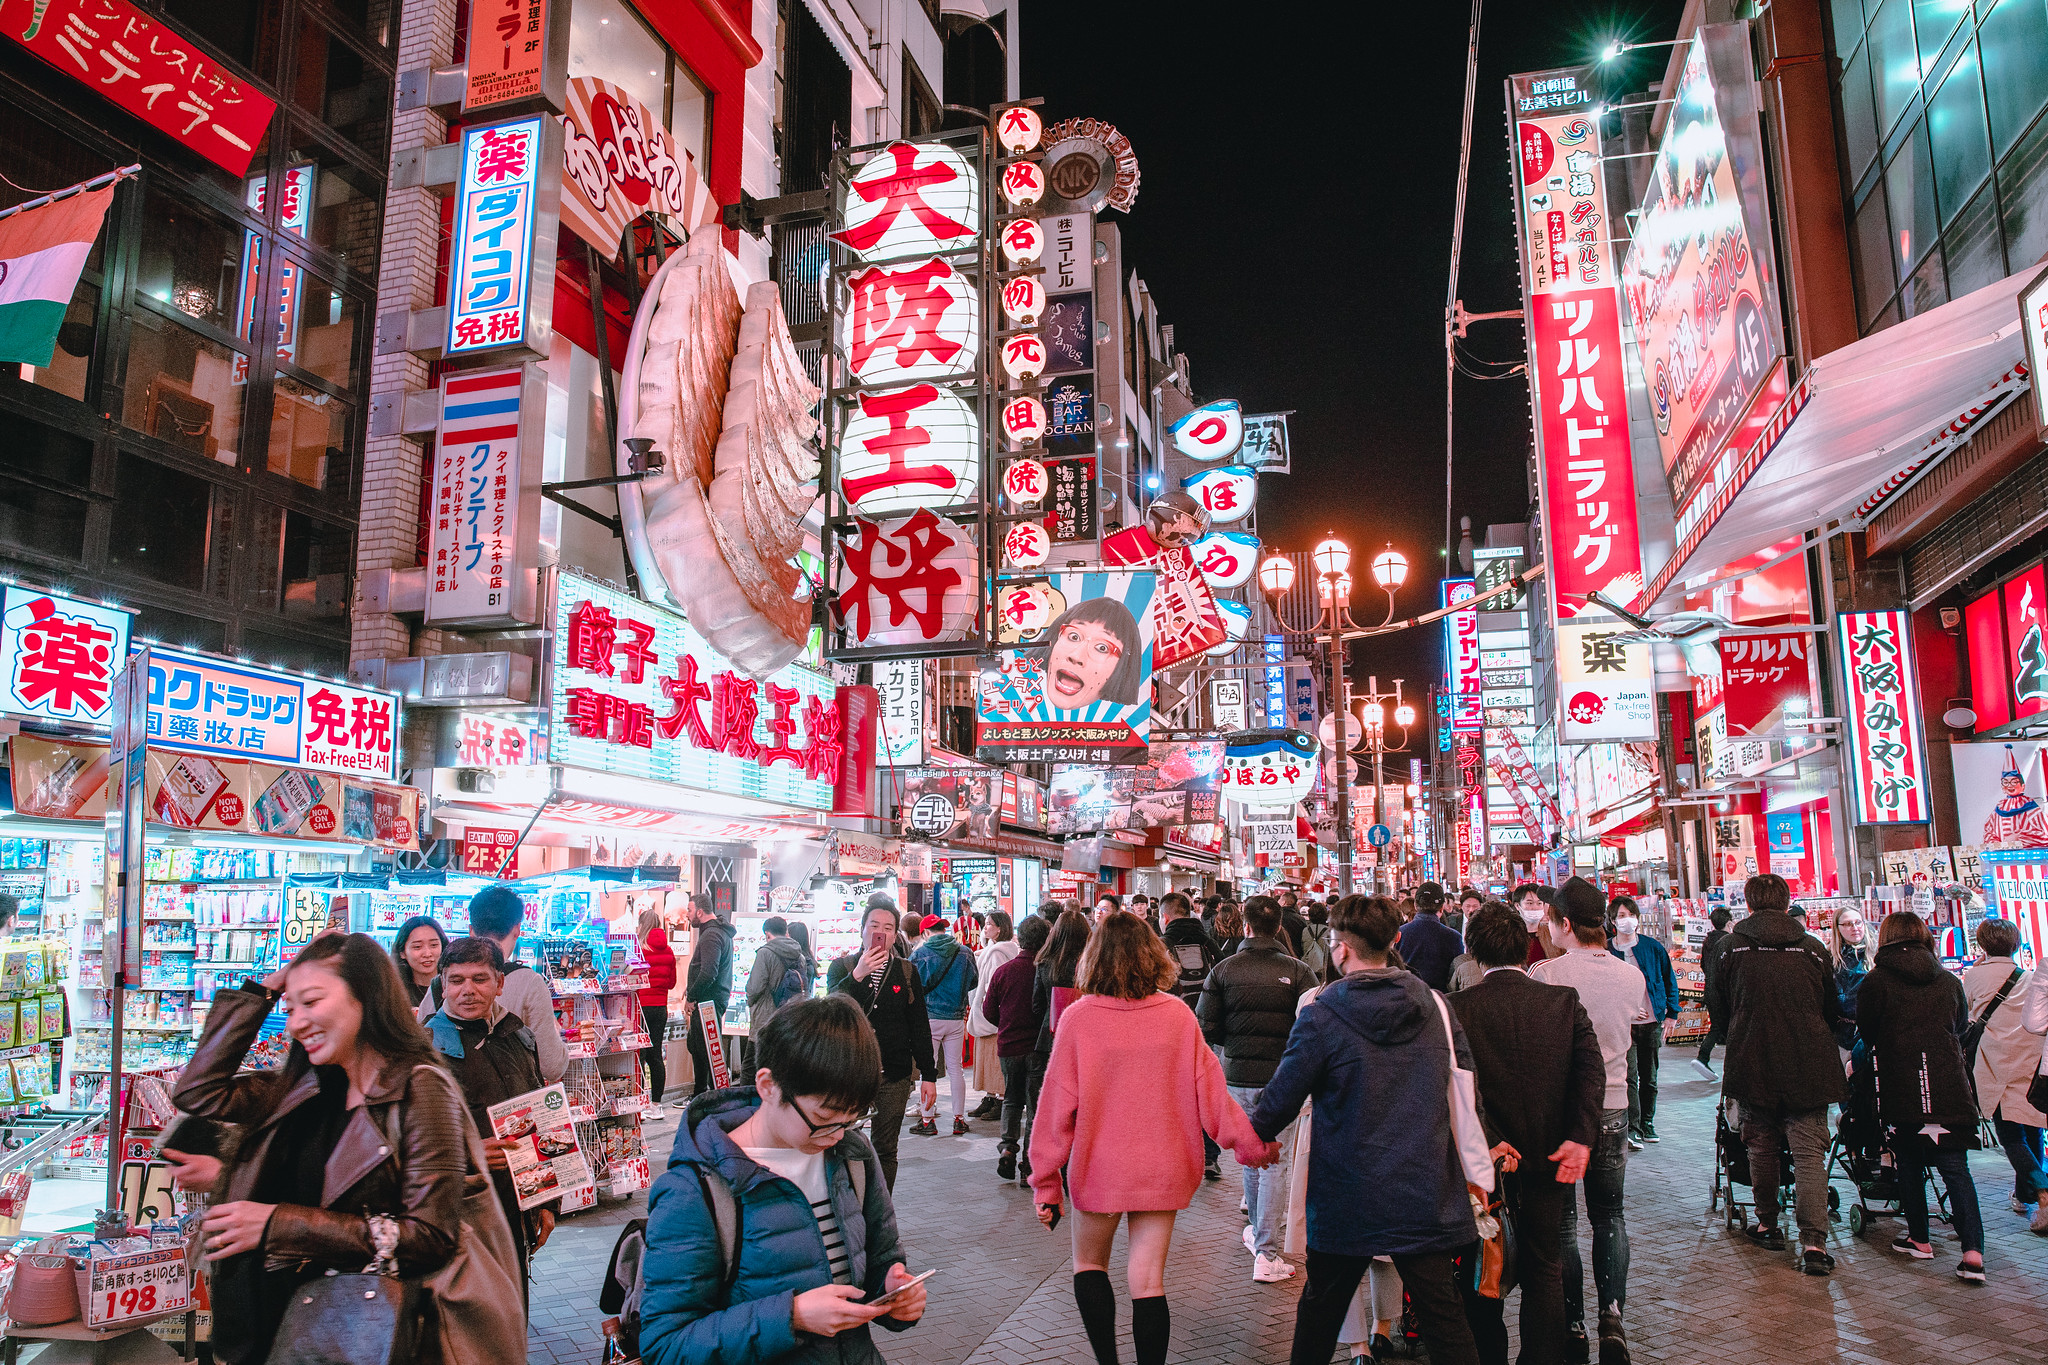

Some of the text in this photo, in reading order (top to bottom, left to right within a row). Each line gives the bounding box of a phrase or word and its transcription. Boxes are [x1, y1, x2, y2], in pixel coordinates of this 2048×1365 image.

[525, 40, 539, 52] 2F
[55, 13, 251, 151] ミティラー
[472, 72, 497, 82] INDIAN
[472, 73, 516, 88] RESTAURANT
[525, 67, 539, 76] BAR
[1532, 77, 1576, 95] 道頓堀
[1519, 90, 1592, 112] 法善寺ビル
[1040, 117, 1116, 153] NIKOH
[475, 130, 530, 184] 薬
[1060, 165, 1089, 188] NK
[469, 188, 522, 310] ダイコク
[1533, 230, 1545, 260] 当ビル
[454, 311, 521, 349] 免税
[1738, 307, 1761, 378] 4F
[1053, 325, 1083, 366] James
[1003, 108, 1047, 625] 大阪名物元祖焼餃子
[827, 141, 981, 643] 大阪王将
[1054, 405, 1082, 417] BAR
[1044, 423, 1093, 436] OCEAN
[1551, 299, 1618, 576] ツルハドラッグ
[465, 443, 491, 571] クンテープ
[435, 457, 452, 592] タイ調味料 食材店
[448, 455, 465, 591] タイカルチャースクール
[488, 450, 508, 606] タイ料理とタイスキの店 B1
[569, 600, 658, 684] 餃子
[1582, 633, 1626, 673] 薬
[1724, 638, 1804, 663] ツルハ
[19, 618, 112, 712] 薬
[1000, 657, 1044, 675] しもと
[1457, 614, 1482, 718] ジャンカラ
[1727, 666, 1790, 685] ドラッグ
[984, 676, 1043, 695] エンタメ
[1617, 692, 1649, 700] Japan.
[911, 700, 919, 735] CAFE
[982, 695, 1043, 715] ショップ
[1614, 702, 1650, 711] Tax-free
[1628, 711, 1651, 720] Shop
[1854, 624, 1917, 810] 大阪みやげ
[306, 688, 390, 753] 免税
[655, 654, 845, 787] 大阪王将
[305, 744, 390, 773] Tax-Free 면세
[1510, 750, 1523, 760] CAFE
[907, 769, 1000, 778] MAMESHIBA CAFE OSAKA
[219, 798, 238, 806] NOW
[221, 811, 243, 821] SALE!
[312, 809, 329, 817] NOW
[468, 832, 493, 843] EAT IN
[1257, 825, 1295, 835] PASTA
[1715, 820, 1740, 847] 薬
[1259, 840, 1295, 850] PIZZA
[1285, 855, 1297, 863] 2F
[1960, 855, 1982, 890] 平成
[286, 887, 326, 920] 13%
[582, 979, 599, 989] 398
[106, 1285, 156, 1319] 198
